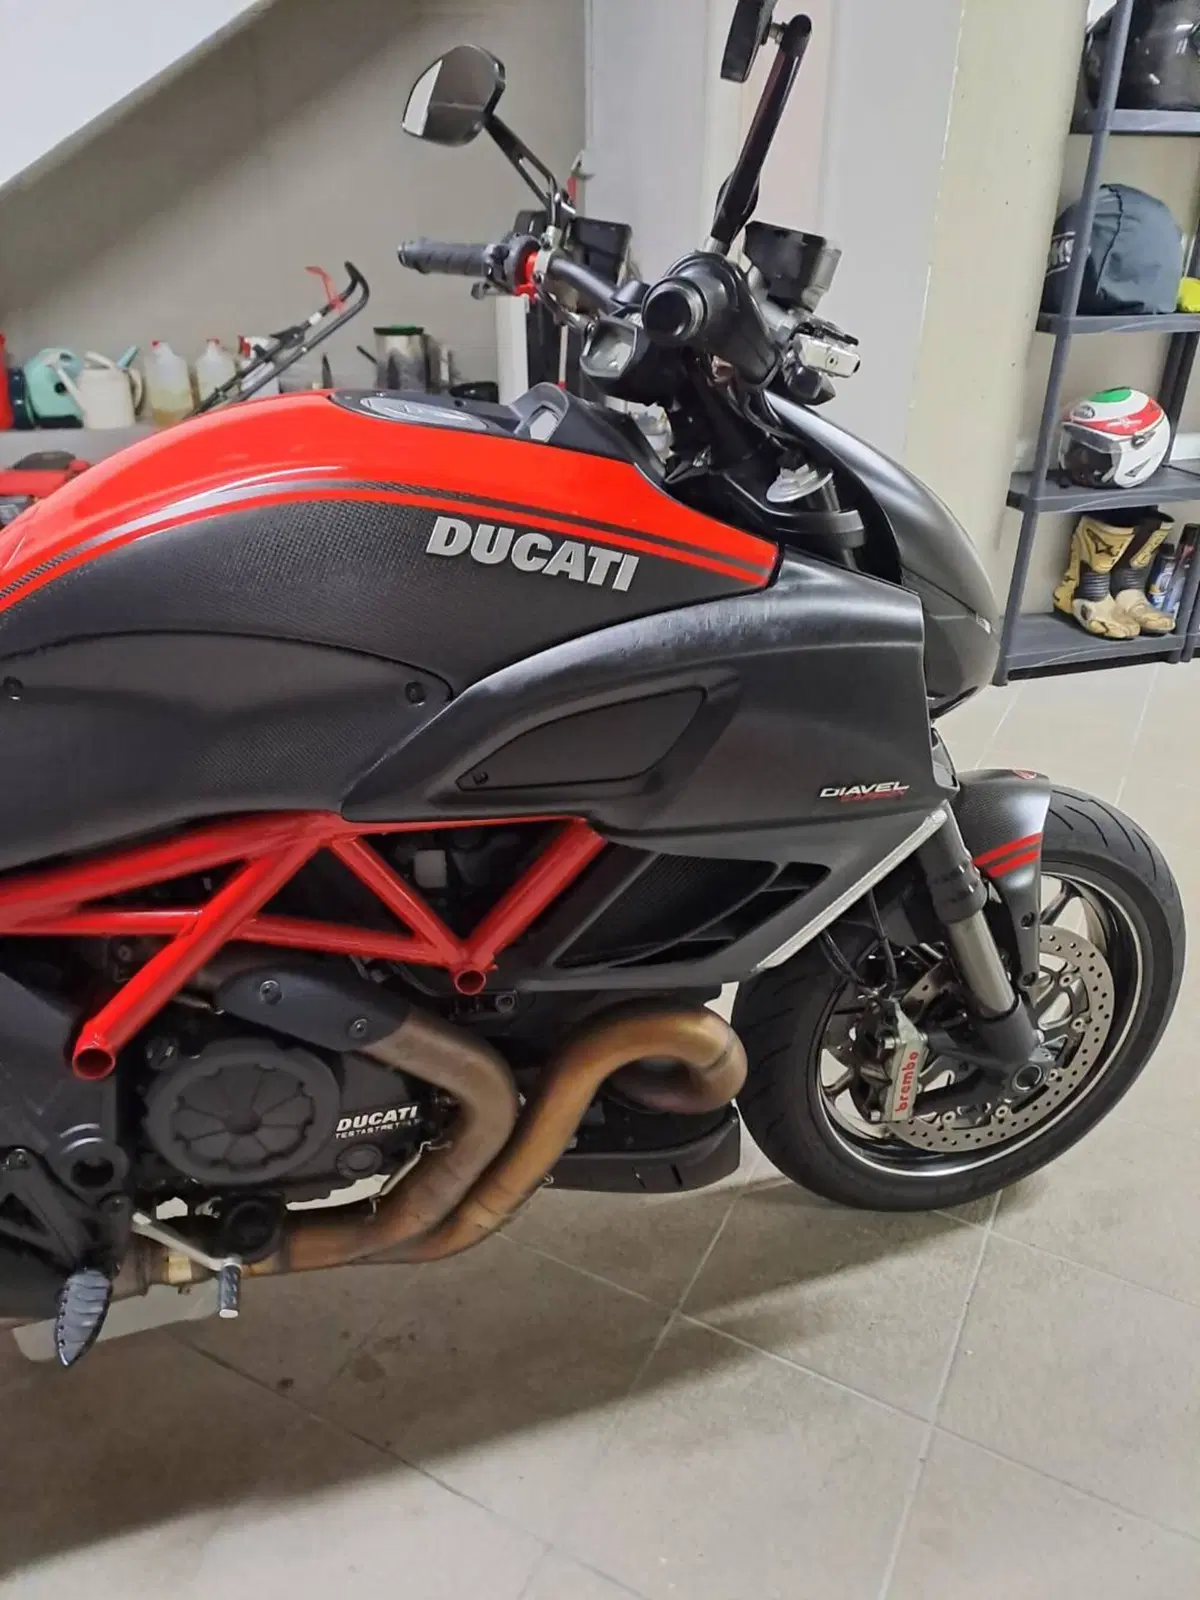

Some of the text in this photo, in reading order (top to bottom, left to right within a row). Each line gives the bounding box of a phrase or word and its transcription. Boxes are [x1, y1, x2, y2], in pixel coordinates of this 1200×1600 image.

[426, 516, 639, 592] DUCATI
[820, 781, 910, 798] DIAVEL
[894, 1051, 919, 1112] brembo
[336, 1105, 418, 1132] DUCATI
